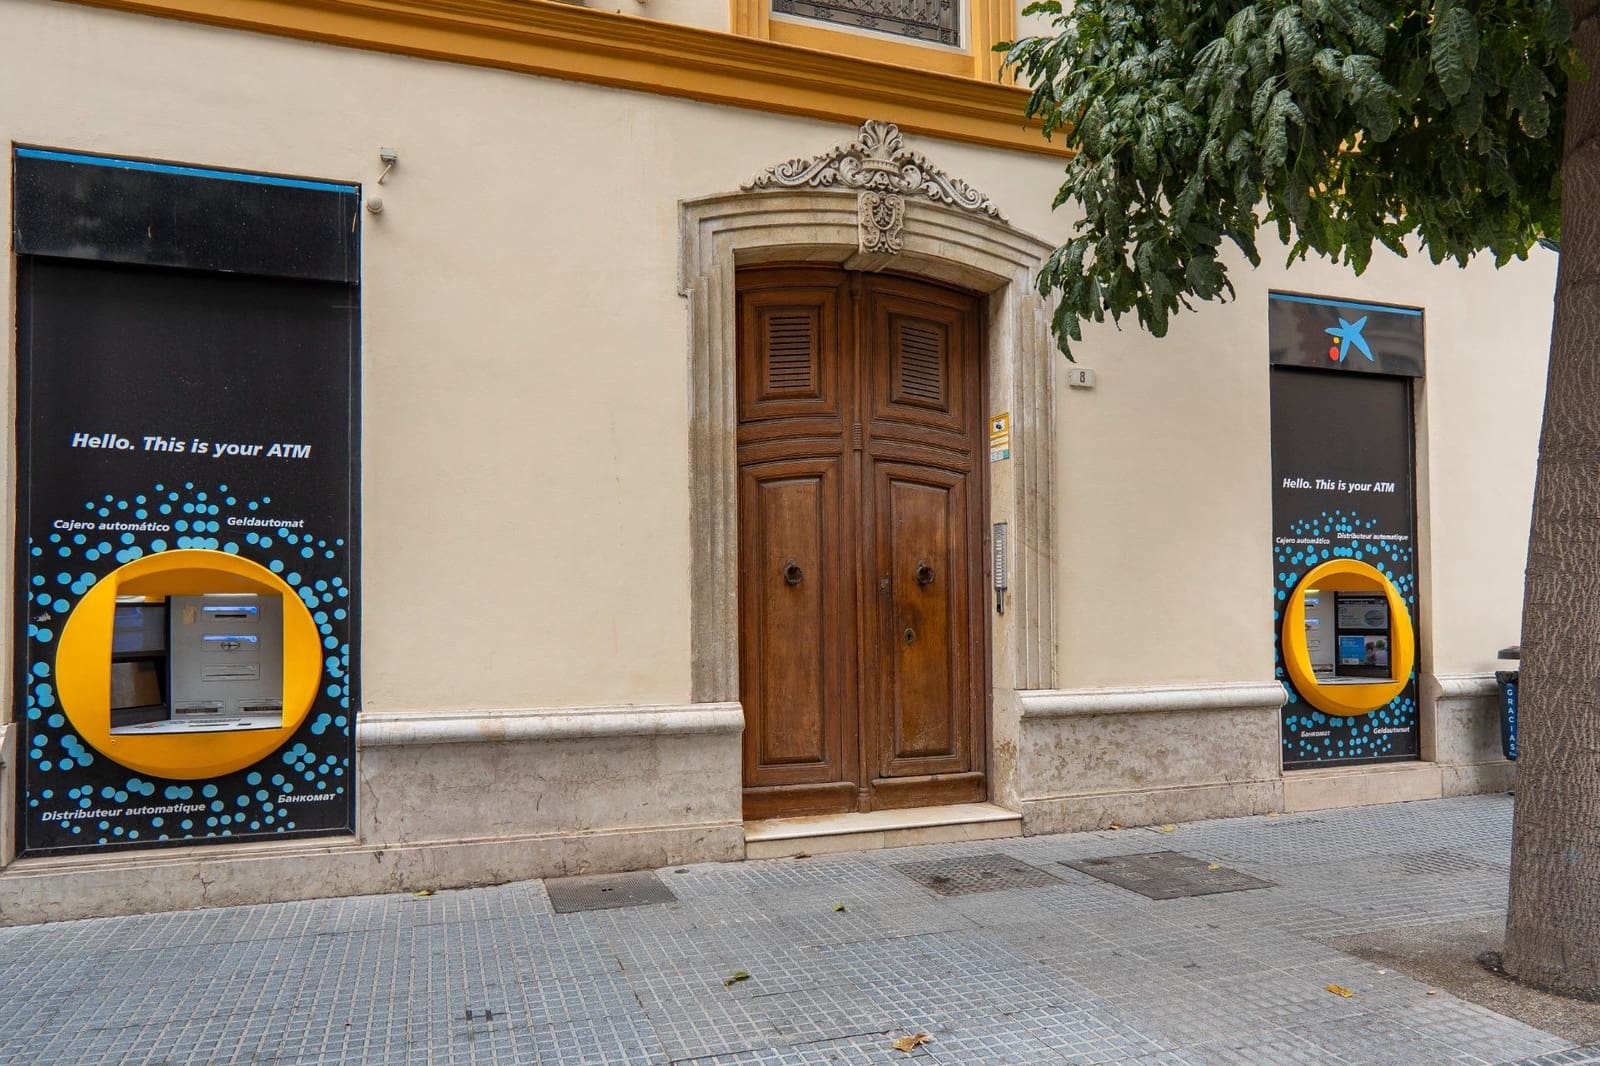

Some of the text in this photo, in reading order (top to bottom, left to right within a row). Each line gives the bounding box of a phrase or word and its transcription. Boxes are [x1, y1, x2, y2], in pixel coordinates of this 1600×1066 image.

[1079, 371, 1086, 383] 8
[71, 432, 312, 459] Hello. This is your ATM
[1282, 477, 1395, 493] Hello. This is your ATM
[53, 519, 170, 533] Cajero automático
[227, 516, 305, 529] Geldautomat
[1276, 537, 1330, 546] Cajero automático
[1337, 532, 1409, 541] Distributeur automatique
[1506, 689, 1517, 751] GRACIAS
[277, 792, 336, 804] Банкомат
[41, 801, 206, 822] Distributeur automatique
